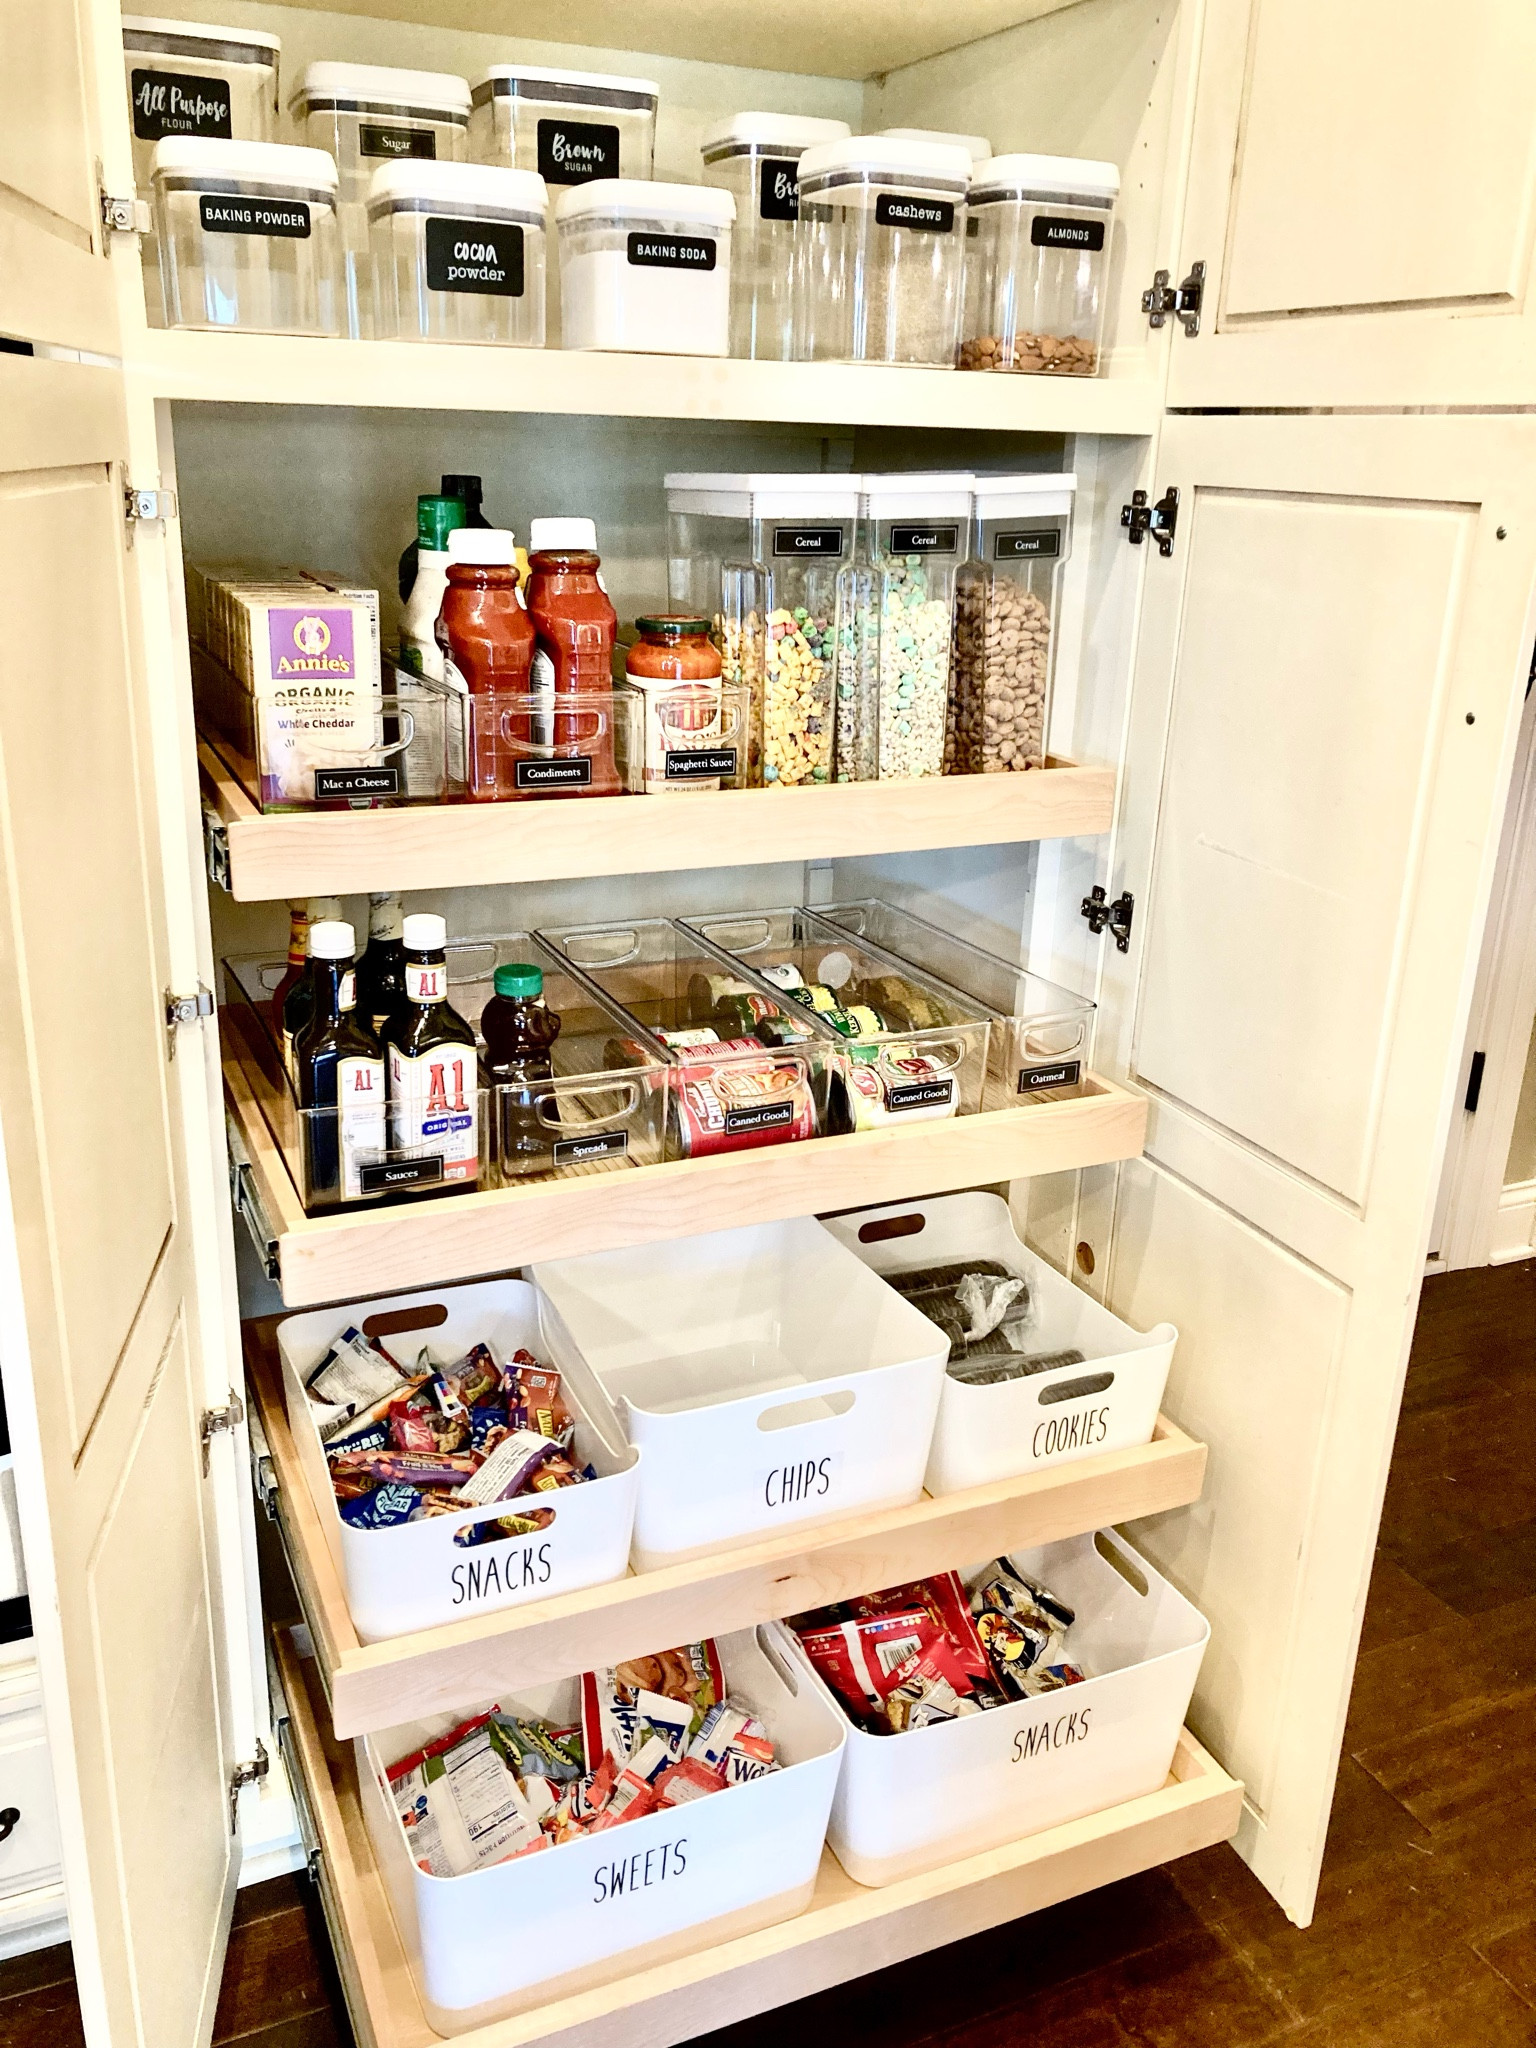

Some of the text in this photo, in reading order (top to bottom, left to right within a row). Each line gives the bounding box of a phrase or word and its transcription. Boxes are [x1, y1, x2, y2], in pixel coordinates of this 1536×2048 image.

[135, 81, 228, 125] All Purpose
[161, 117, 193, 130] FLOUR
[381, 135, 411, 152] Sugar
[552, 132, 606, 162] Brown
[564, 161, 593, 173] SUGAR
[205, 207, 305, 227] BAKING POWDER
[888, 204, 942, 221] cashews
[1047, 227, 1089, 241] ALMONDS
[454, 242, 498, 265] cocoa
[637, 243, 707, 260] BAKING SODA
[447, 265, 506, 281] powder
[795, 536, 821, 547] Cereal
[911, 535, 937, 545] Cereal
[1015, 540, 1040, 550] Cereal
[277, 653, 351, 674] Annie's
[312, 718, 355, 729] Cheddar
[669, 758, 733, 772] Spaghetti Sauce
[527, 768, 581, 779] Condiments
[322, 780, 344, 789] Mac
[354, 777, 390, 788] Cheese
[1030, 1070, 1066, 1084] Oatmeal
[893, 1088, 949, 1104] Canned Goods
[729, 1109, 790, 1127] Canned Goods
[572, 1142, 608, 1157] Spreads
[385, 1170, 418, 1181] Sauces
[1032, 1406, 1110, 1458] COOKIES
[764, 1456, 832, 1507] CHIPS
[451, 1543, 552, 1605] SNACKS
[1011, 1708, 1092, 1763] SNACKS
[593, 1838, 688, 1904] SWEETS
